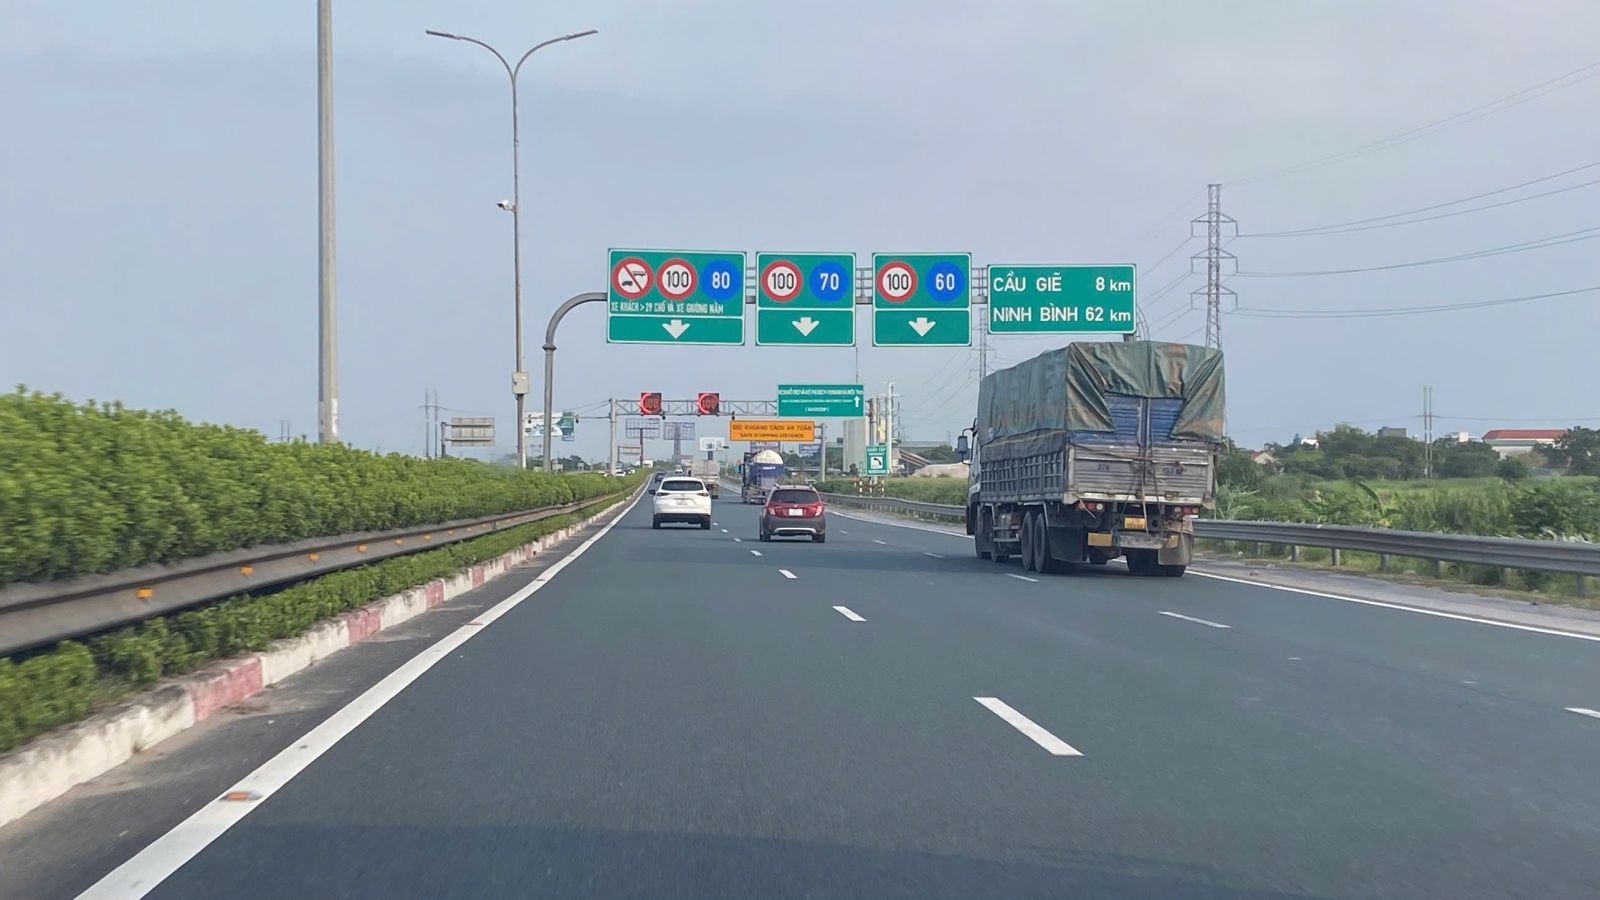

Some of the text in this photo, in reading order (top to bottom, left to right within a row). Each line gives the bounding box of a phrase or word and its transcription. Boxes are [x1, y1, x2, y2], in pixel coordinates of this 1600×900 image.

[666, 271, 689, 288] 100
[712, 271, 730, 289] 80
[772, 273, 794, 290] 100
[820, 273, 839, 291] 70
[887, 273, 909, 291] 100
[935, 273, 955, 291] 60
[993, 271, 1131, 292] CẦU GIẼ 8 km
[676, 303, 684, 313] XE
[993, 302, 1131, 322] NINH BÌNH 62 km
